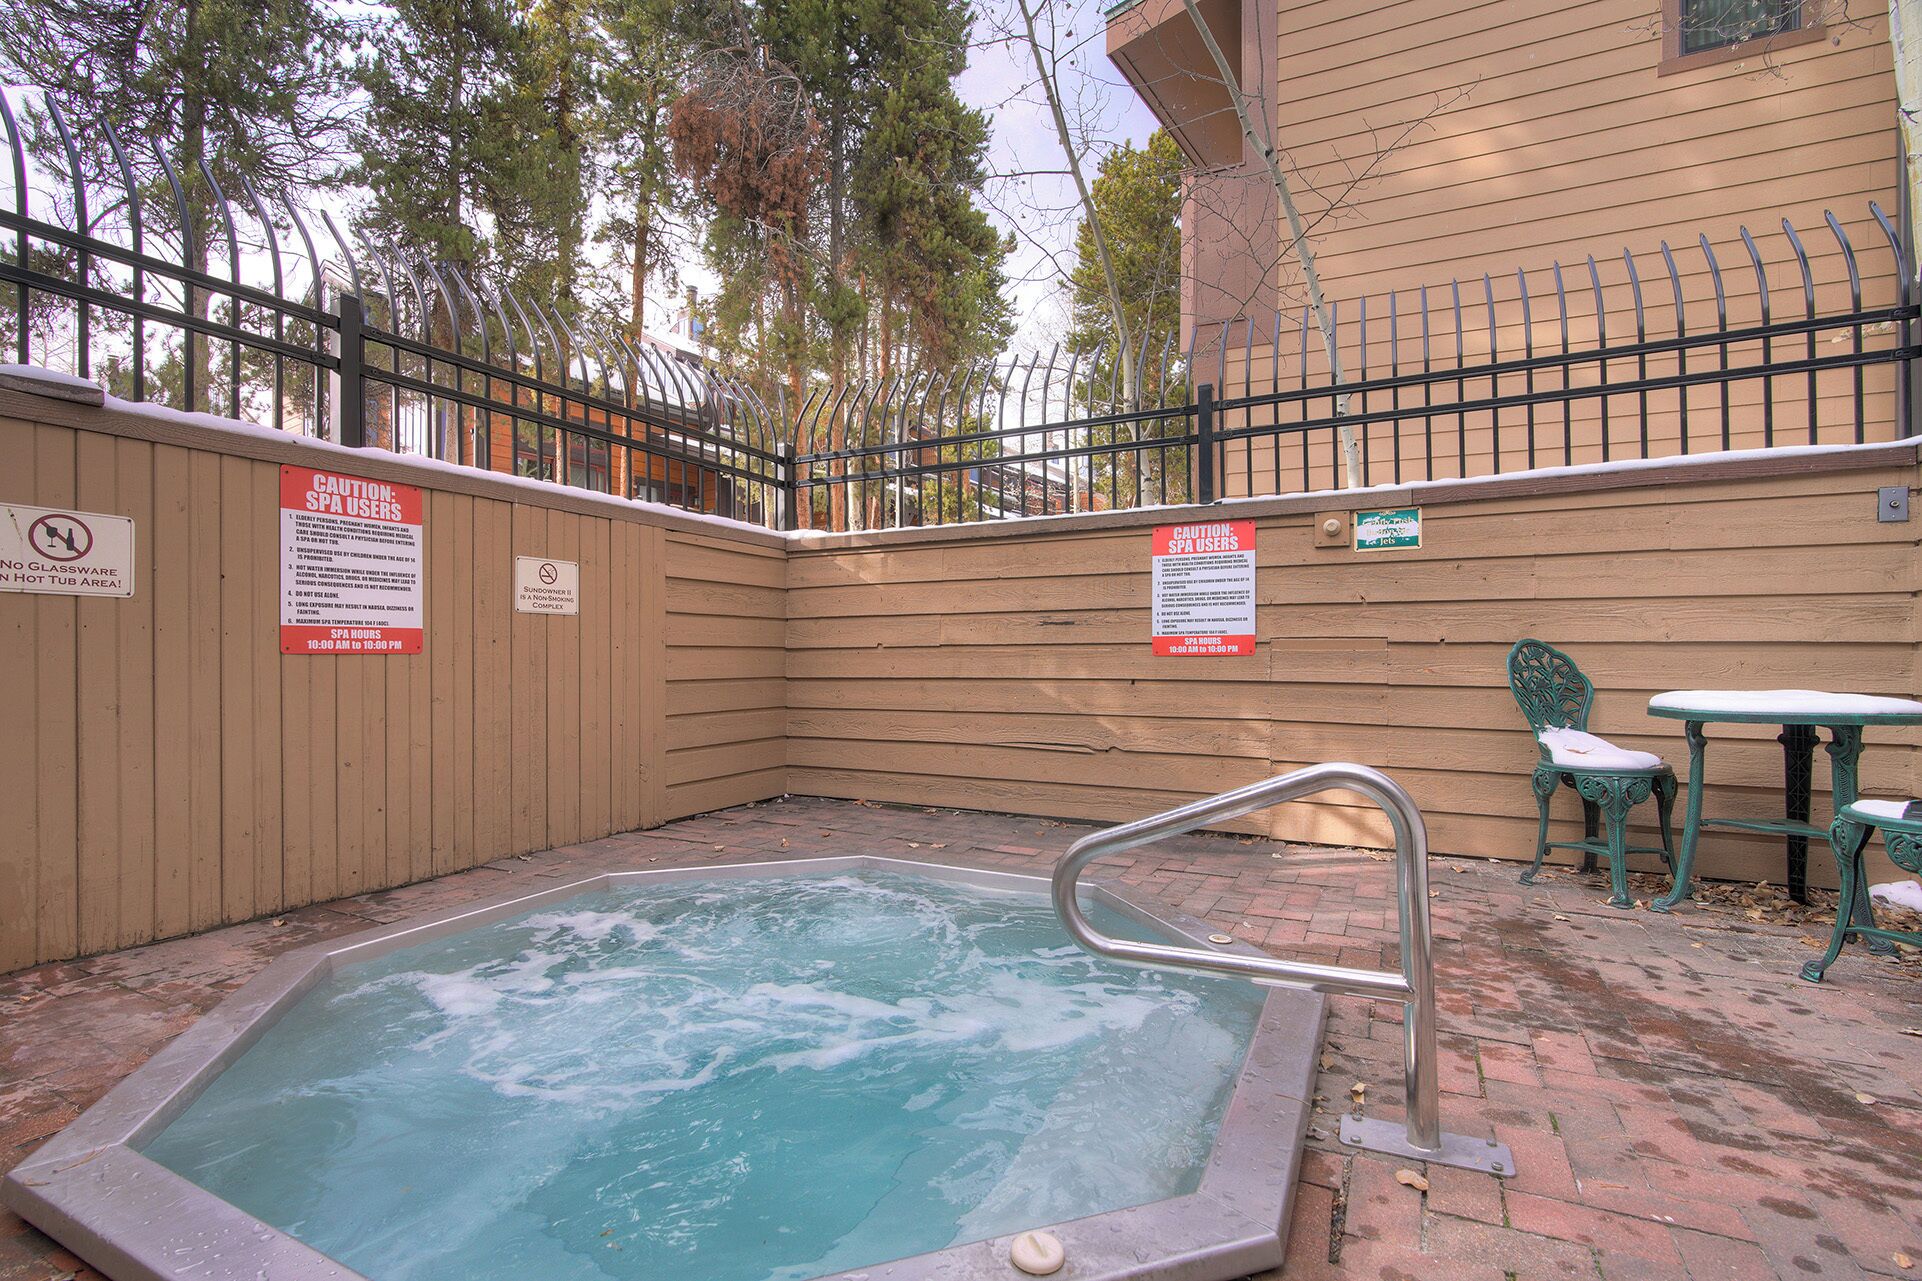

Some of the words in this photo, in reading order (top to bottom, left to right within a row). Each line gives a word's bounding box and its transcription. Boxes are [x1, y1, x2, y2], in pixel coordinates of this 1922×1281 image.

[314, 474, 396, 502] CAUTION:
[306, 491, 343, 514] SPA
[347, 497, 402, 521] USERS
[1174, 524, 1234, 540] CAUTION:
[1168, 540, 1194, 554] SPA
[1196, 536, 1238, 552] USERS
[14, 573, 45, 583] HOT
[48, 576, 77, 585] TUB
[331, 629, 349, 638] SPA
[351, 629, 381, 639] HOURS
[307, 640, 334, 649] 10:00
[335, 640, 350, 649] AM
[352, 641, 361, 649] to
[363, 640, 388, 649] 10:00
[389, 641, 402, 649] PM
